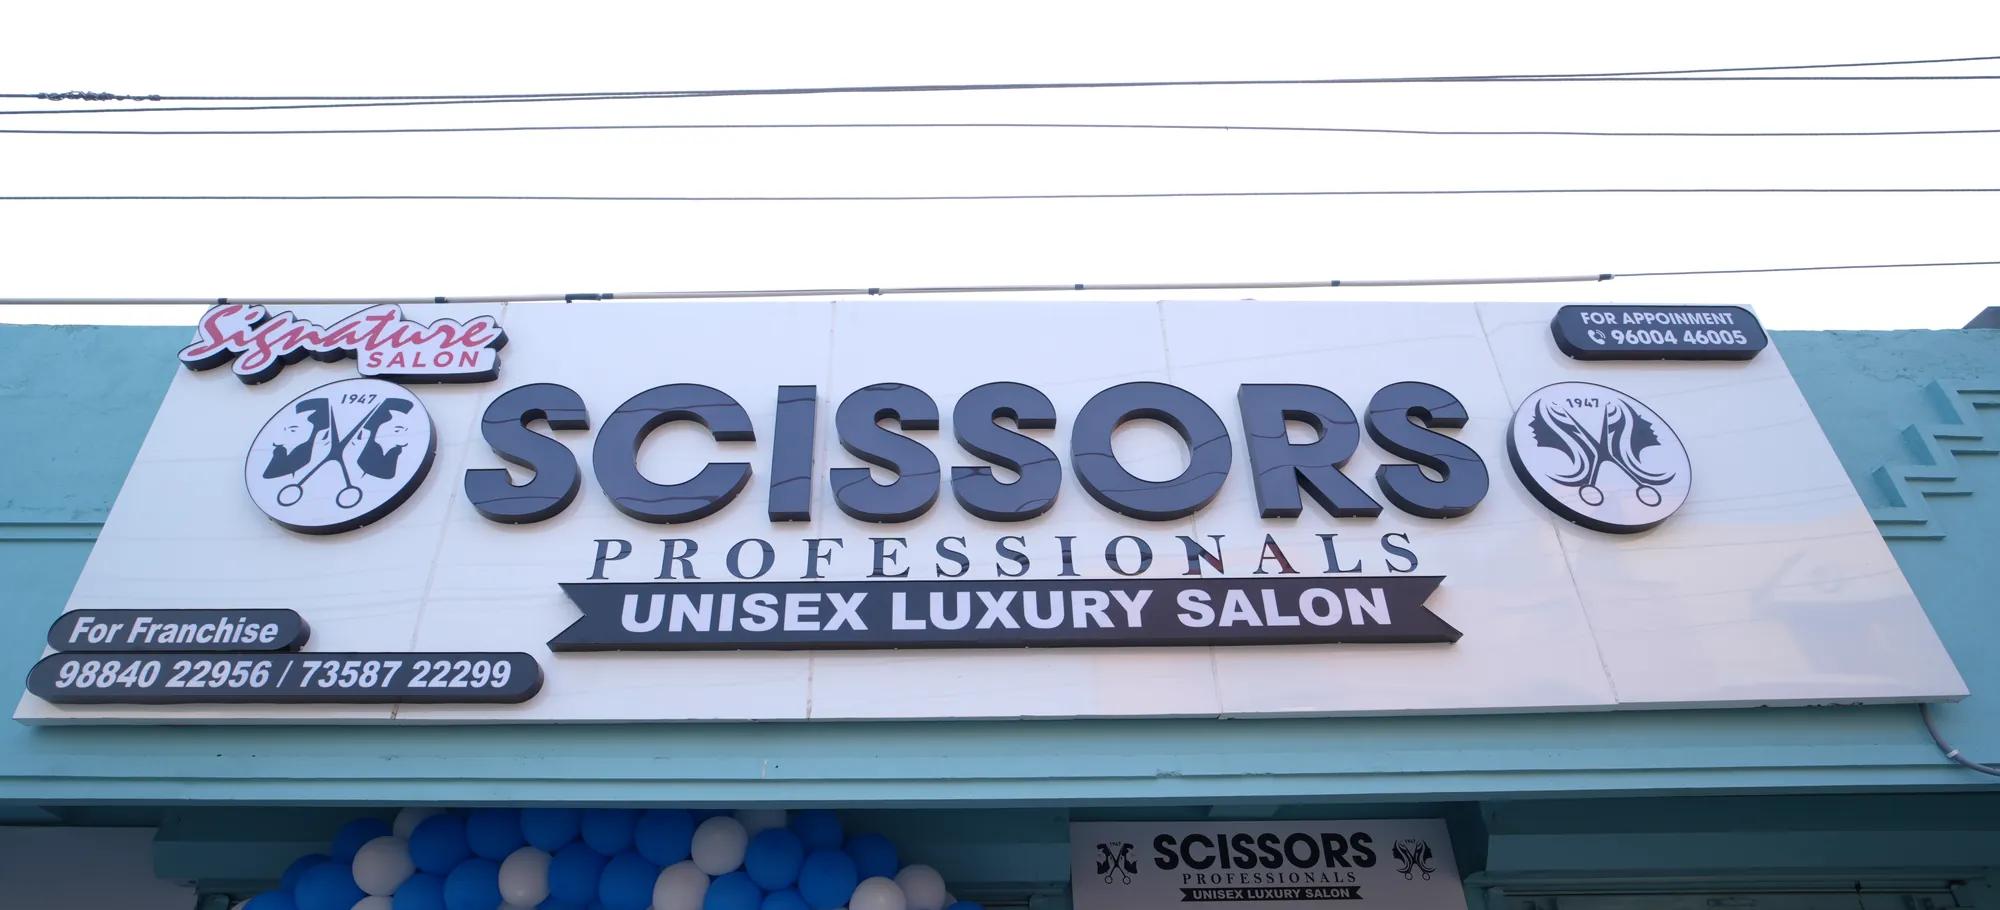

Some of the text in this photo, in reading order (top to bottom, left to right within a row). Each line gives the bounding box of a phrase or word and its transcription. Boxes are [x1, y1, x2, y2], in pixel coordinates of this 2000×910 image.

[1580, 311, 1736, 326] FOR APPOINMENT
[187, 304, 496, 371] Signature
[1611, 330, 1748, 346] 96004 46005
[367, 350, 480, 368] SALON
[341, 393, 377, 405] 1947
[1566, 398, 1600, 409] 1947
[464, 381, 1489, 524] SCISSORS
[586, 533, 1420, 581] PROFESSIONALS
[620, 587, 1393, 633] UNISEX LUXURY SALON
[69, 616, 279, 643] For Franchise
[54, 660, 512, 688] 98840 22956 / 73587 22299
[1153, 832, 1377, 870] SCISSORS
[1182, 872, 1357, 884] PROFESSIONALS
[1192, 886, 1351, 900] UNISEX LUXURY SALON
